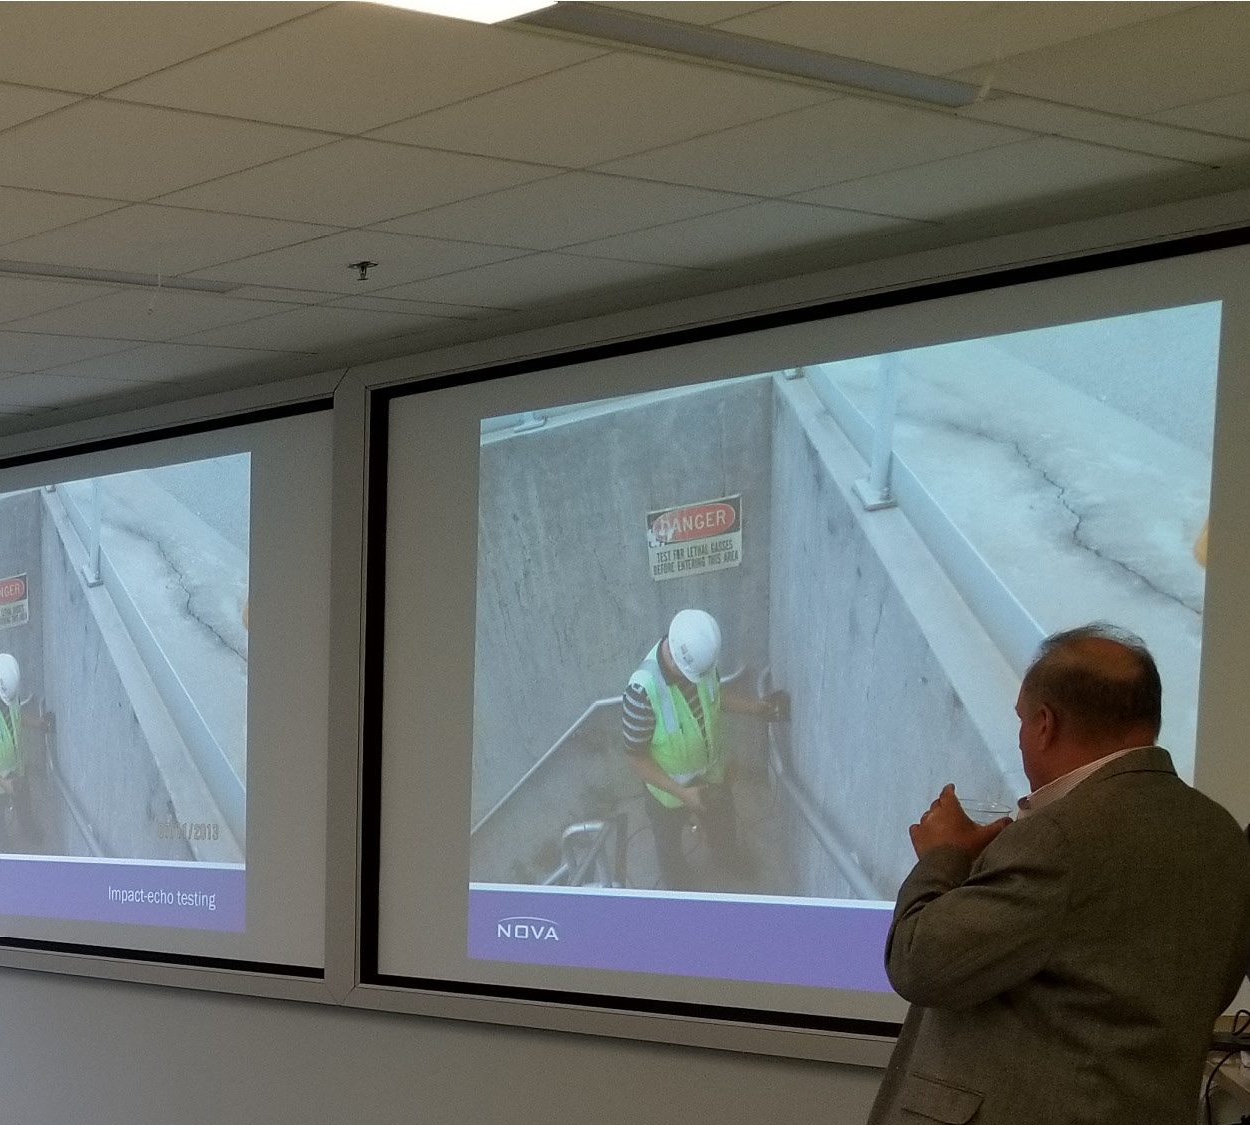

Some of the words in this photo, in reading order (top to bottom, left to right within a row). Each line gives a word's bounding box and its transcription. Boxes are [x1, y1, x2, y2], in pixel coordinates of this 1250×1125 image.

[659, 509, 727, 535] DANGER
[653, 561, 675, 576] BEFORE
[724, 549, 739, 563] AREA
[656, 550, 672, 563] TEST
[673, 548, 685, 560] FOR
[108, 885, 174, 904] Impact-echo
[177, 890, 216, 911] testing
[497, 923, 559, 941] NOVA
